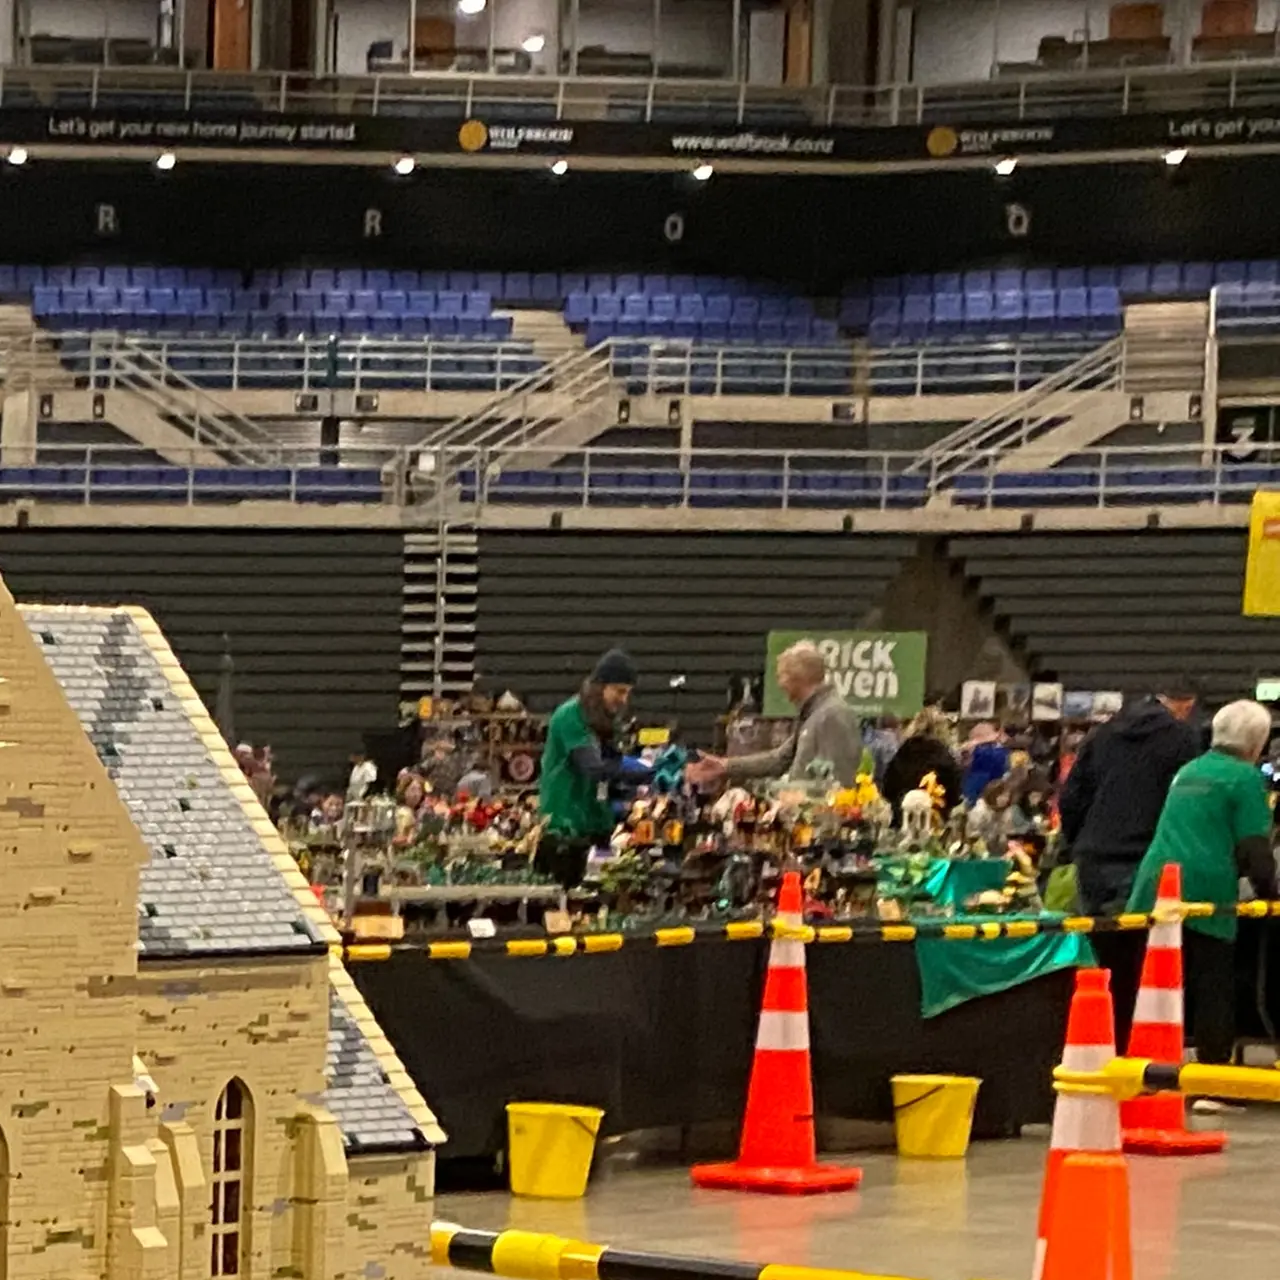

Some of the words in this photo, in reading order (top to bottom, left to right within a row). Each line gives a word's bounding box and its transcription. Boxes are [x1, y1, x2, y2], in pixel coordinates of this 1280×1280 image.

[193, 120, 237, 138] home
[98, 204, 116, 231] R
[364, 208, 382, 236] R
[818, 638, 897, 670] RICK
